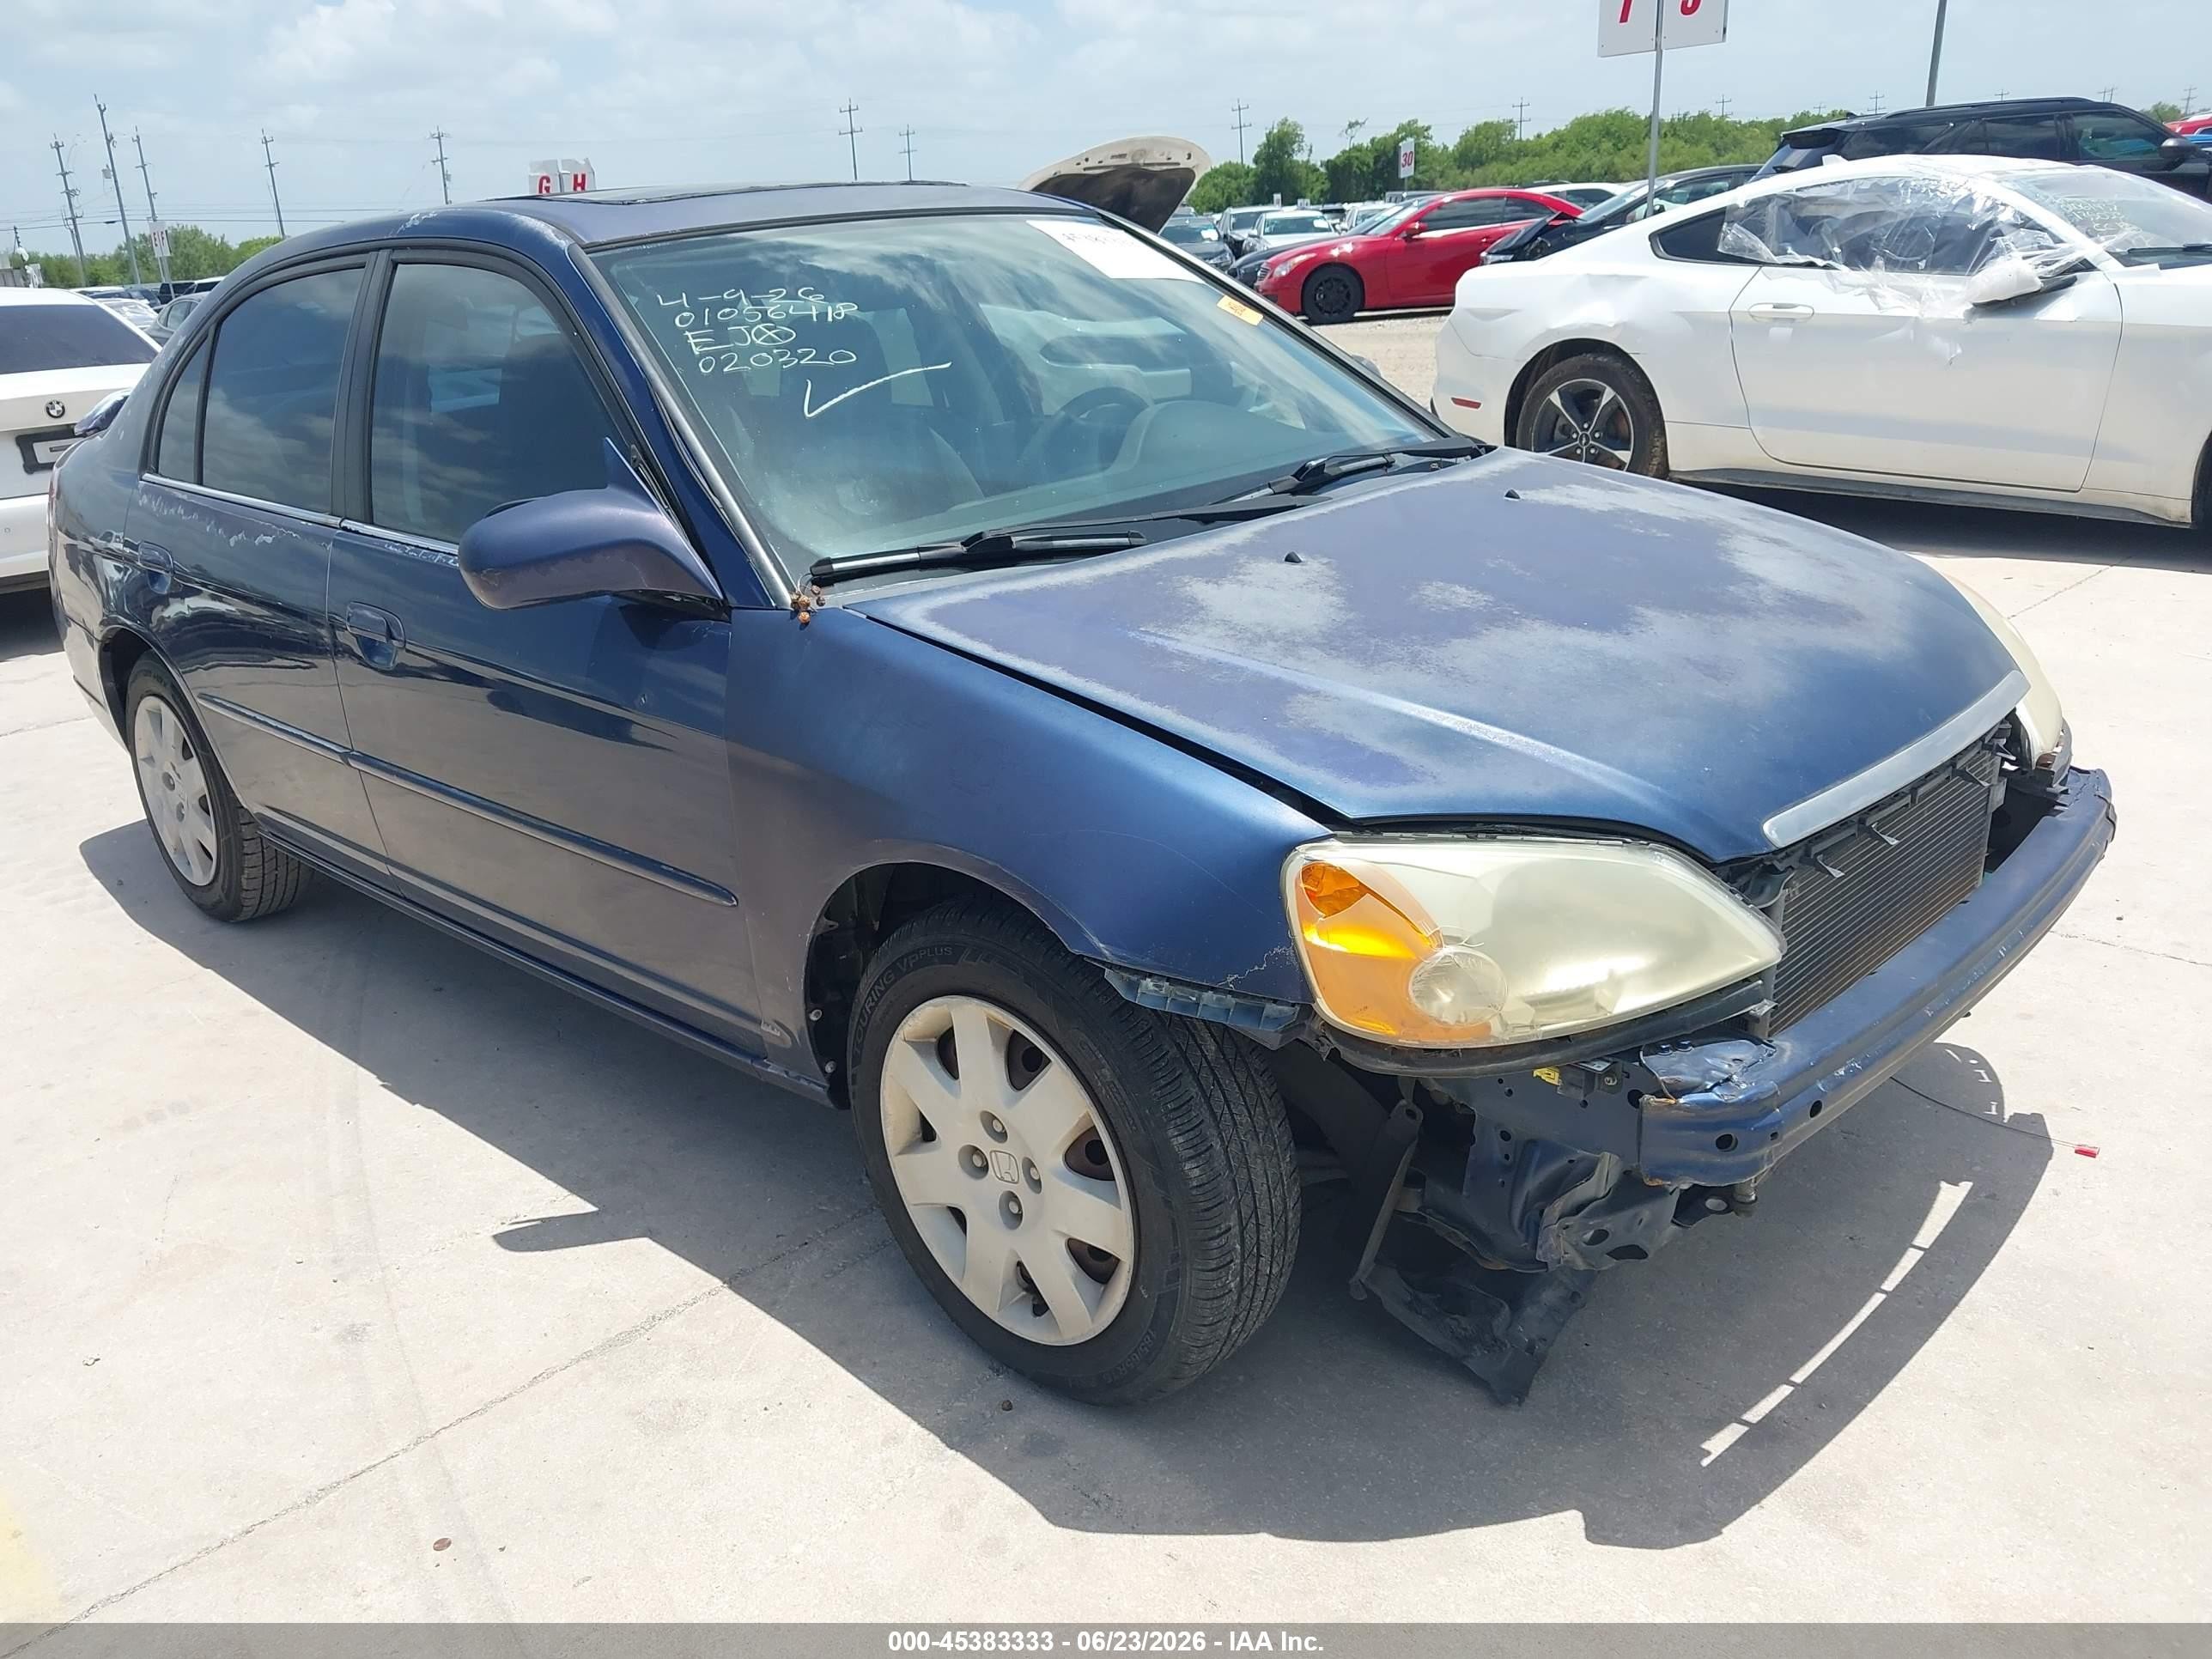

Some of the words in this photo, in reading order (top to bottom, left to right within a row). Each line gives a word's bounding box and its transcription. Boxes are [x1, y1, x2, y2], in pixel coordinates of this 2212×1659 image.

[1401, 150, 1413, 168] 30
[538, 174, 551, 194] G
[573, 173, 586, 191] H
[698, 349, 857, 373] 020320
[854, 969, 895, 1056] TOURING
